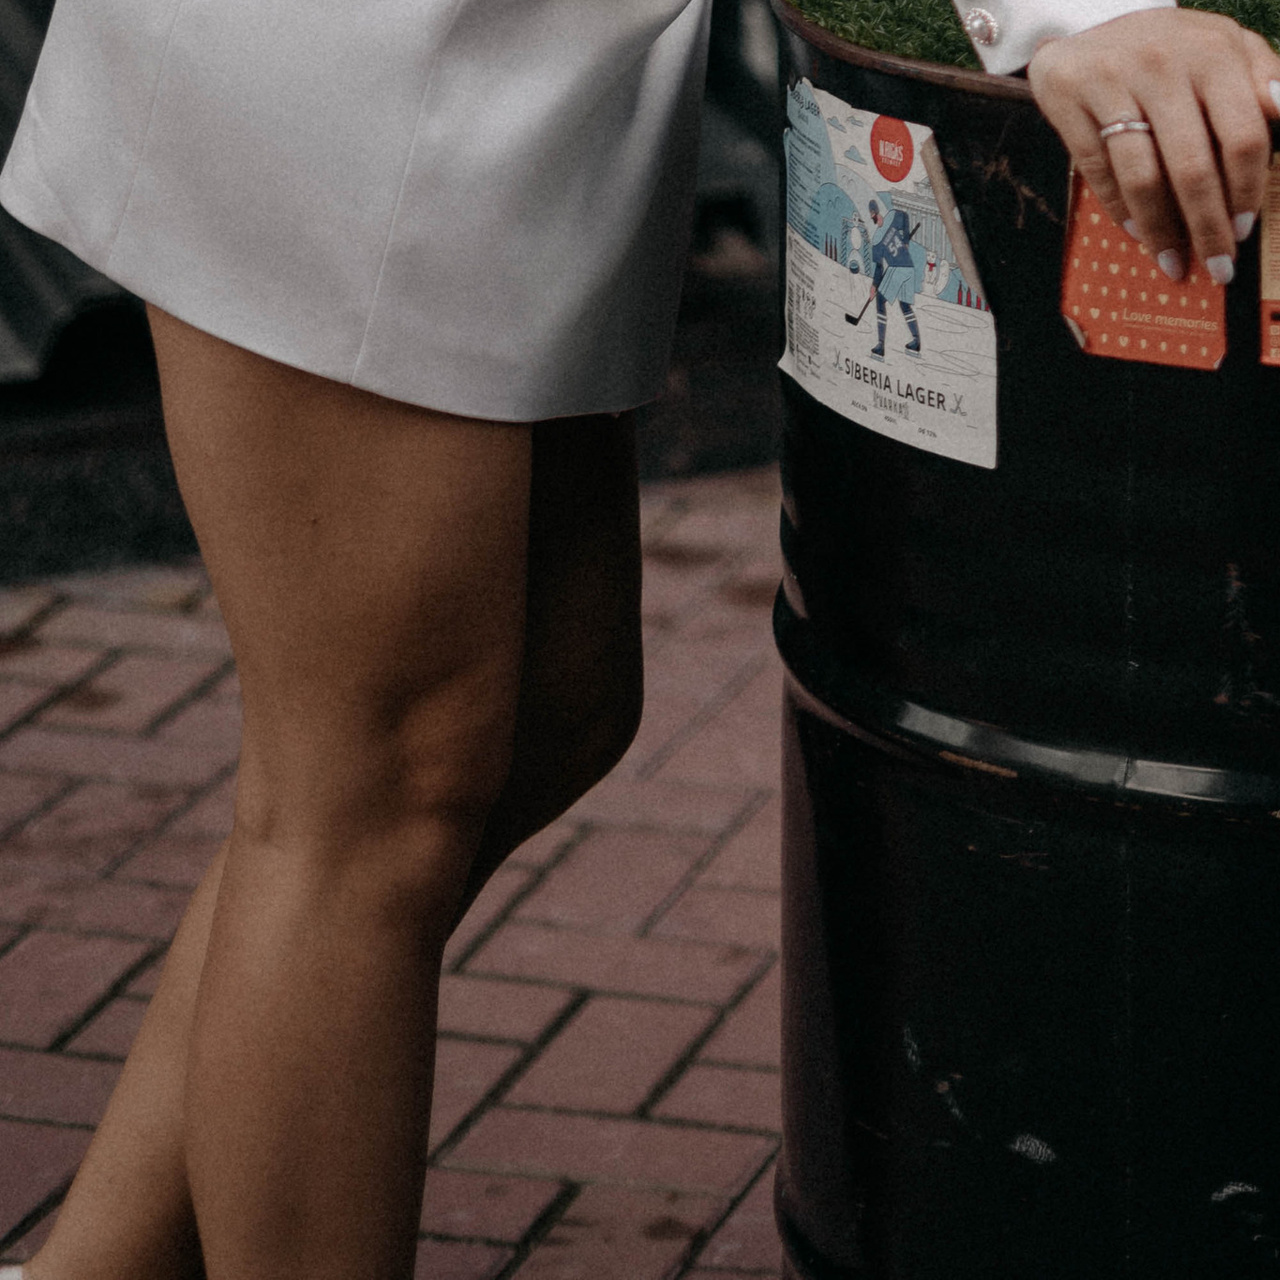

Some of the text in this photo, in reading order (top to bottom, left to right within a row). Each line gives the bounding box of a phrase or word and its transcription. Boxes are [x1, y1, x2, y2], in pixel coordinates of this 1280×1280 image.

[1123, 307, 1152, 323] Love
[1155, 314, 1218, 331] memories
[844, 357, 947, 412] SIBERIA LAGER
